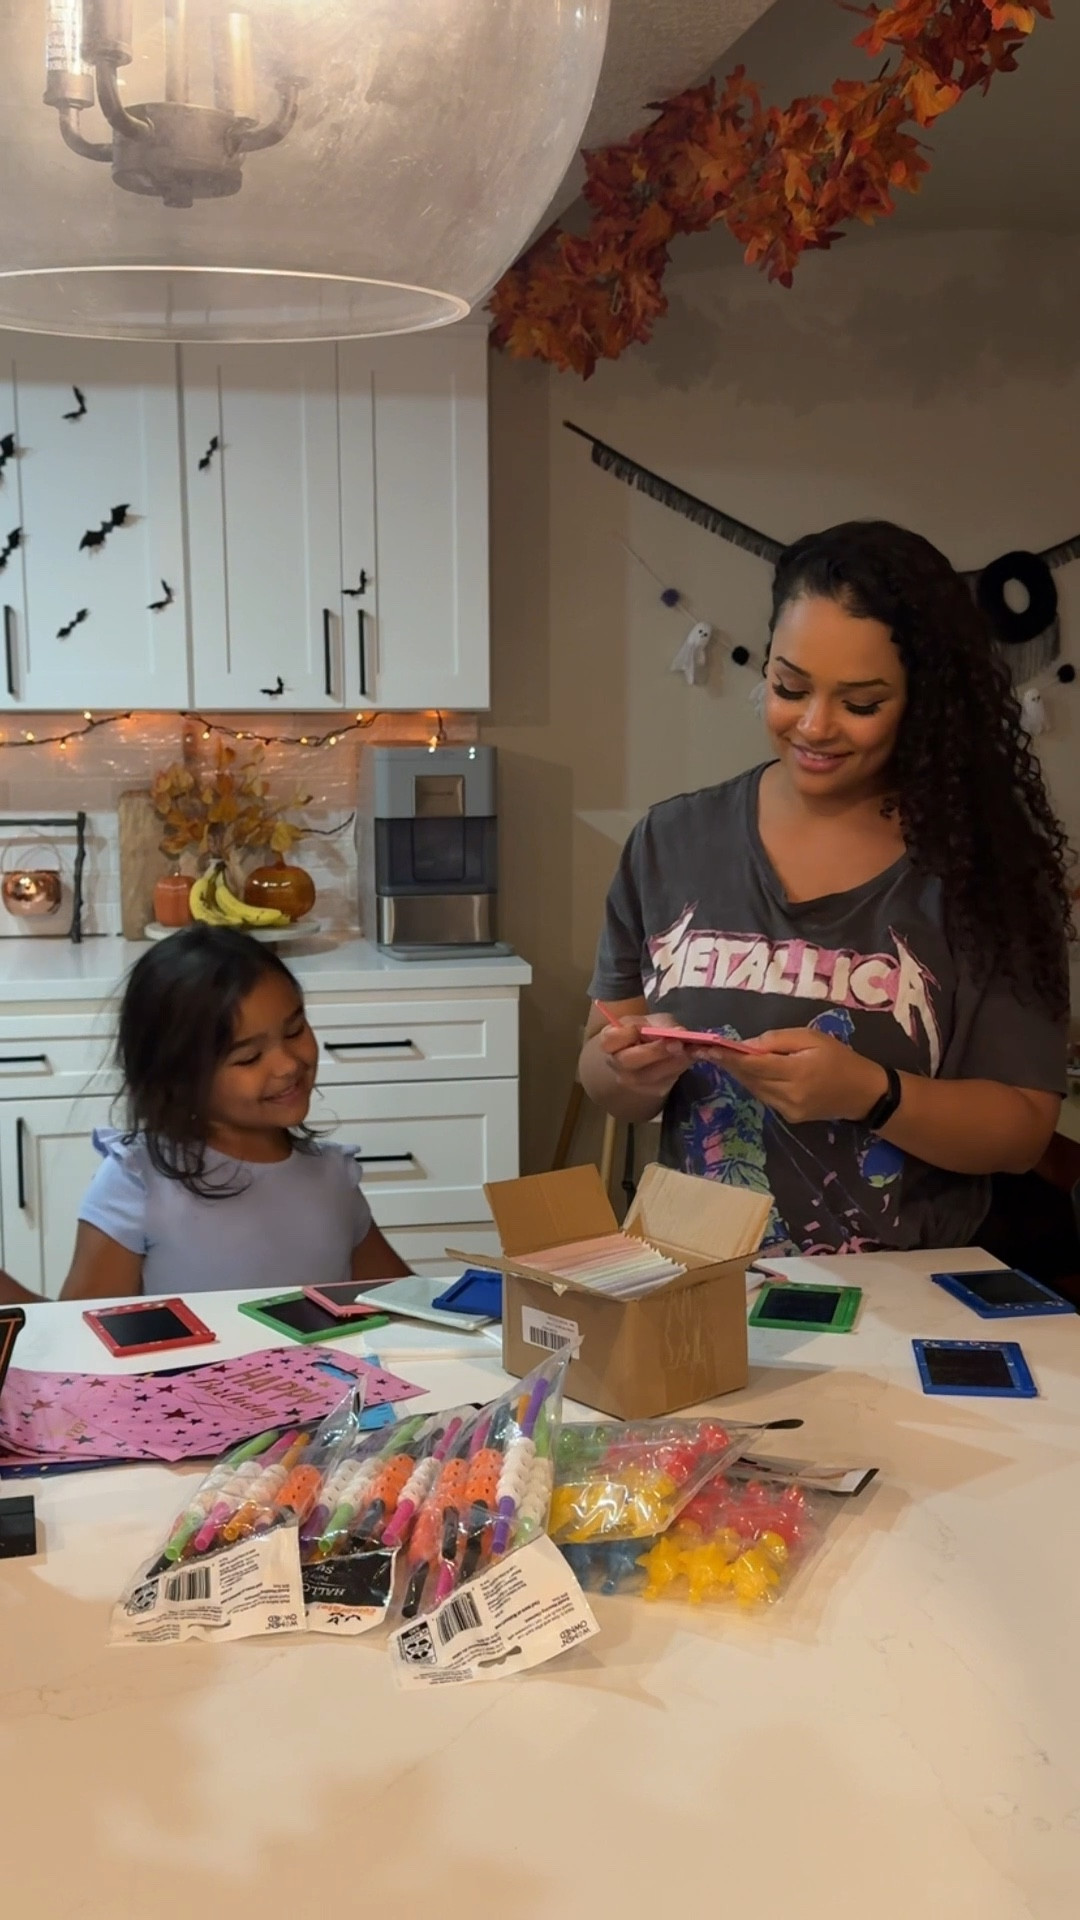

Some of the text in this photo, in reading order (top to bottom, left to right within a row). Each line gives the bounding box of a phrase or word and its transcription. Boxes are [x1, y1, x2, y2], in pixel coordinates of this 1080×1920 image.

[644, 900, 941, 1079] METALLICA
[186, 1379, 278, 1420] Birthday
[223, 1367, 328, 1407] HAPPY
[560, 1620, 588, 1639] OWNED
